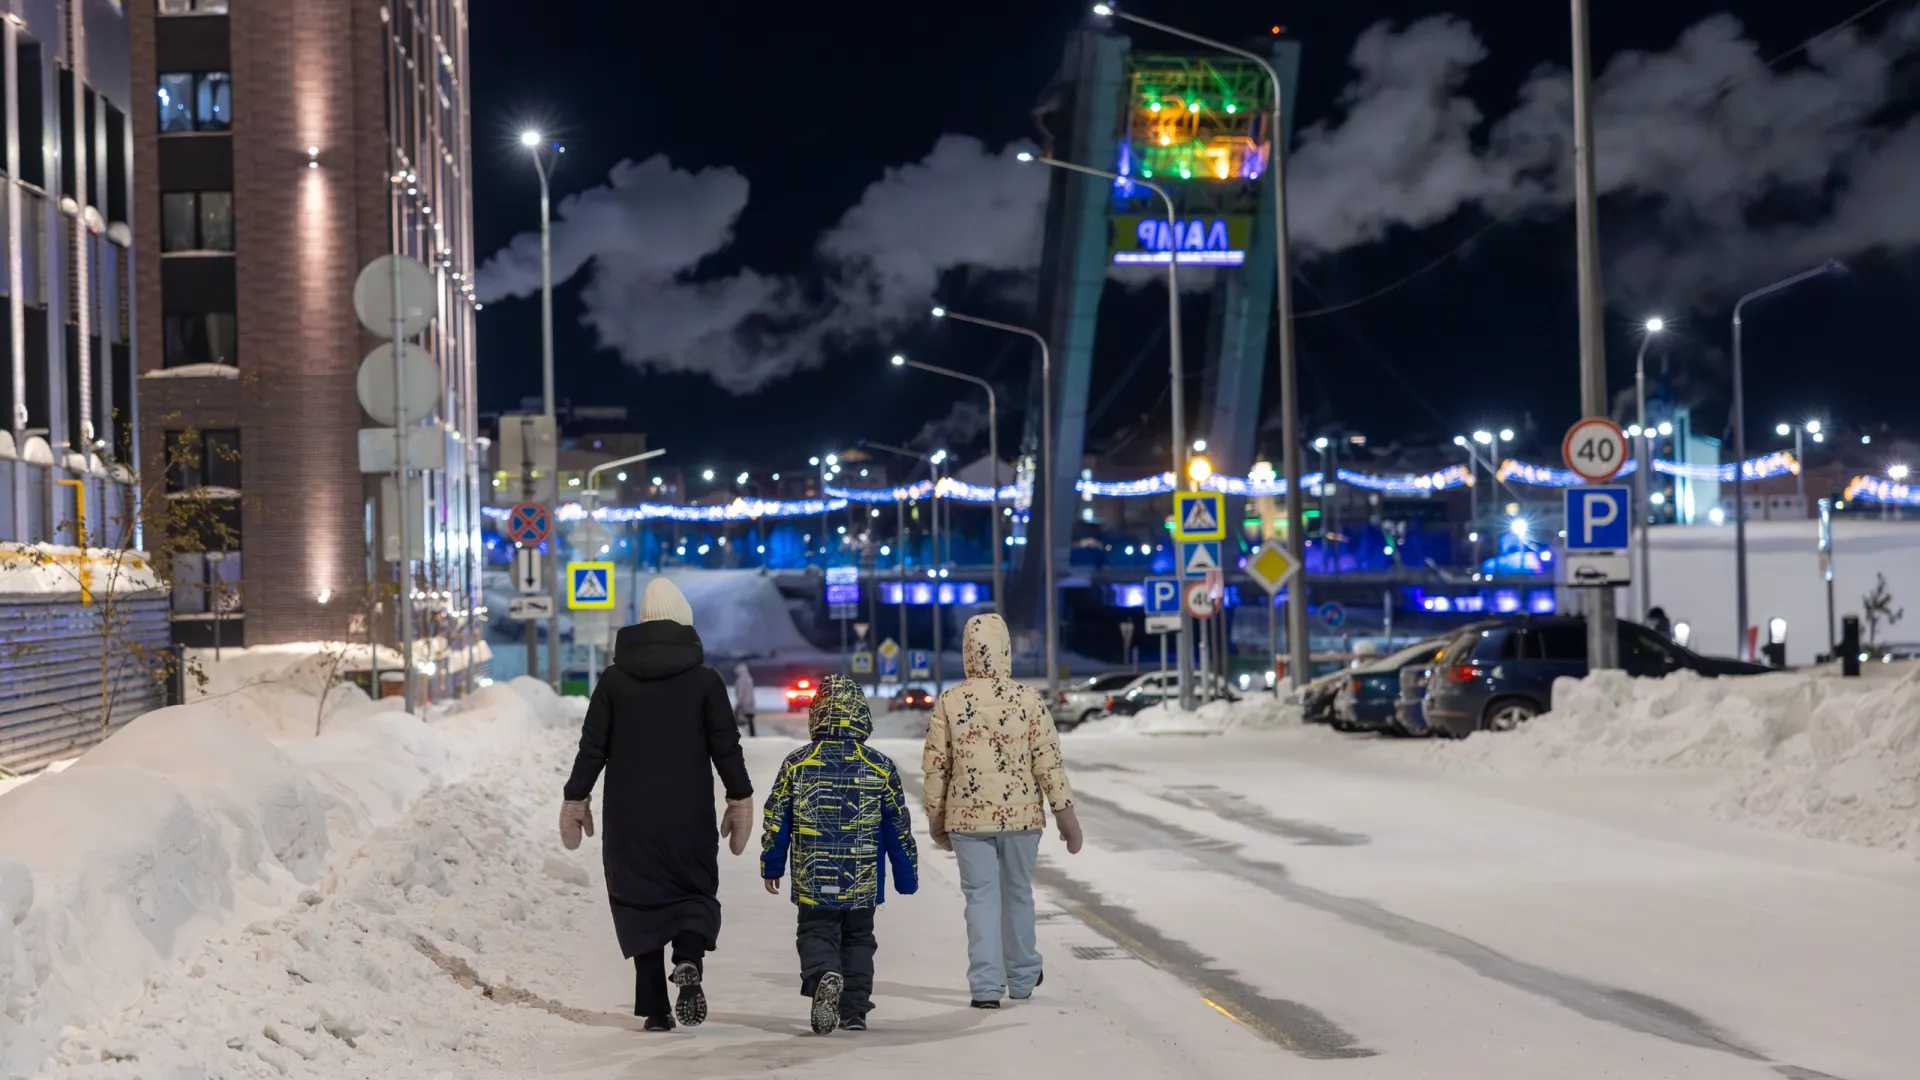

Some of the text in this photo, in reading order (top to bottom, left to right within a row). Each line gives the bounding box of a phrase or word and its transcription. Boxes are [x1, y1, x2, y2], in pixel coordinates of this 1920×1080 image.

[1577, 438, 1615, 462] 40
[1583, 493, 1618, 544] P
[1155, 581, 1175, 611] P
